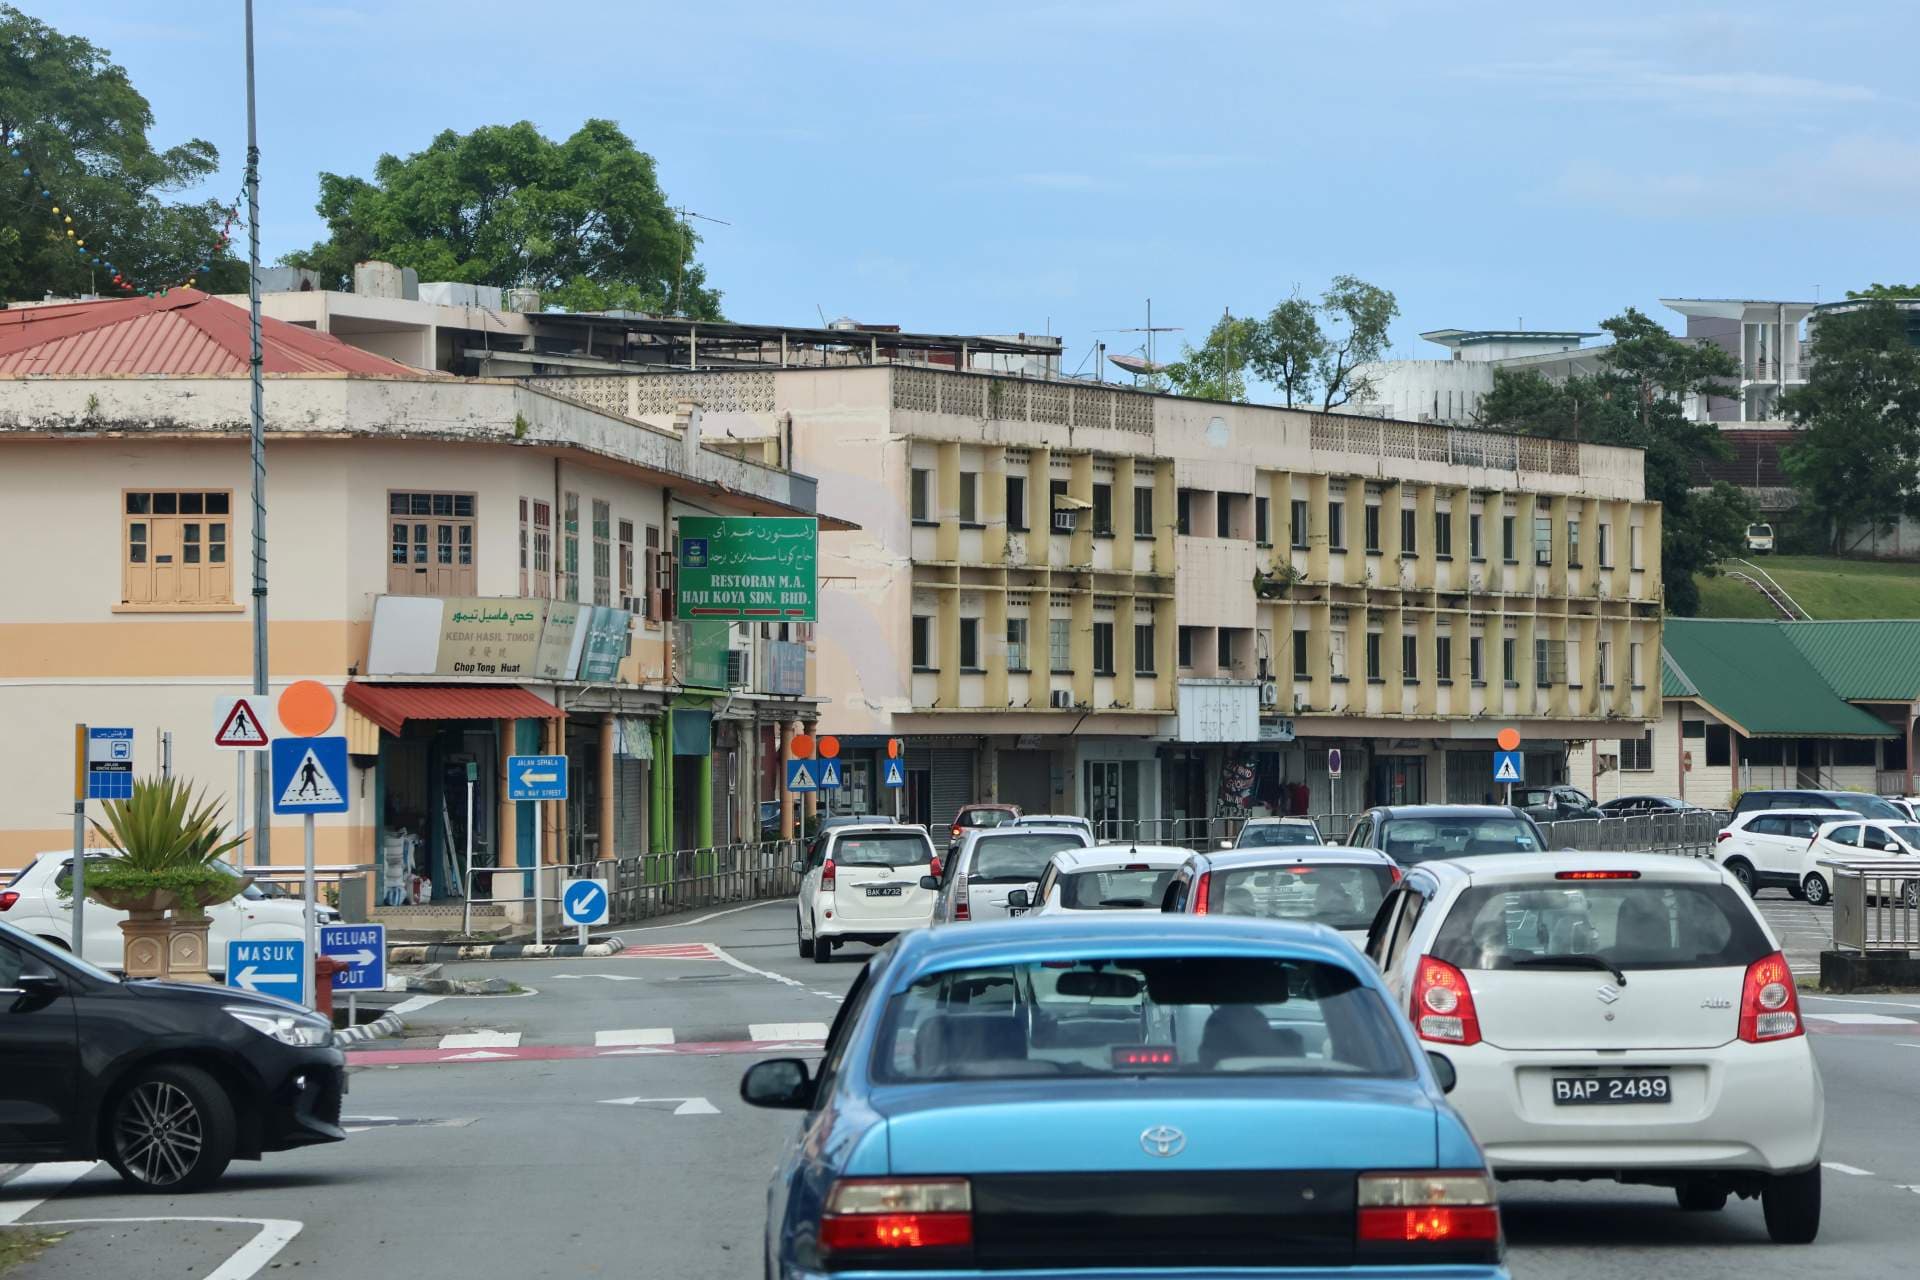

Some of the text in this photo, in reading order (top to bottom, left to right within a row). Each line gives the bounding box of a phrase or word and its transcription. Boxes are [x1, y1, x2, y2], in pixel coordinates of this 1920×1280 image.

[711, 574, 805, 588] RESTORAN M.A.
[682, 591, 811, 605] HAJI KOYA SDN. BHD.
[446, 631, 535, 642] KEDAI HASIL TIMOR
[454, 662, 520, 674] Chop Tong Huat
[541, 789, 561, 797] STREET
[326, 931, 377, 946] KELUAR
[237, 946, 295, 961] MASUK
[339, 970, 365, 984] OUT
[1556, 1079, 1667, 1099] BAP 2489
